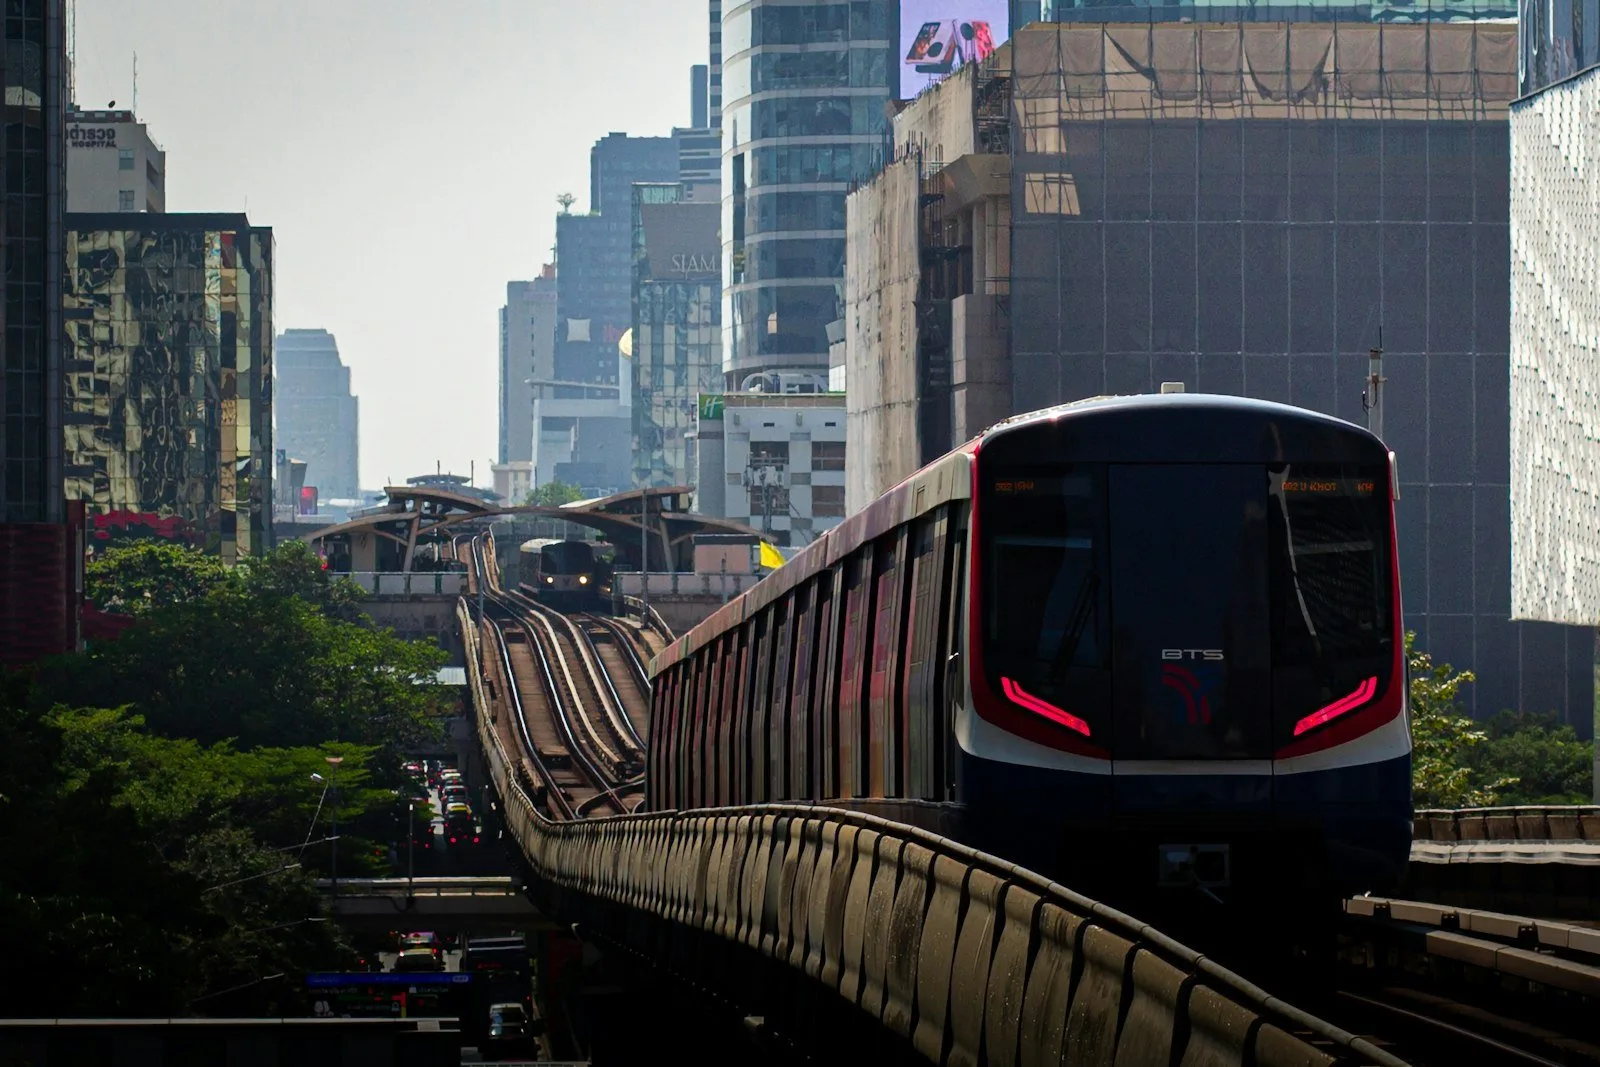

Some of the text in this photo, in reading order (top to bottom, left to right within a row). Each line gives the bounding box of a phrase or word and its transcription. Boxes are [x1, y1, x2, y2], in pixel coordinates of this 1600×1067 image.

[66, 124, 116, 140] ตำรวจ
[72, 140, 117, 148] HOSPITAL
[671, 254, 716, 273] SIAM
[1161, 648, 1225, 660] BTS
